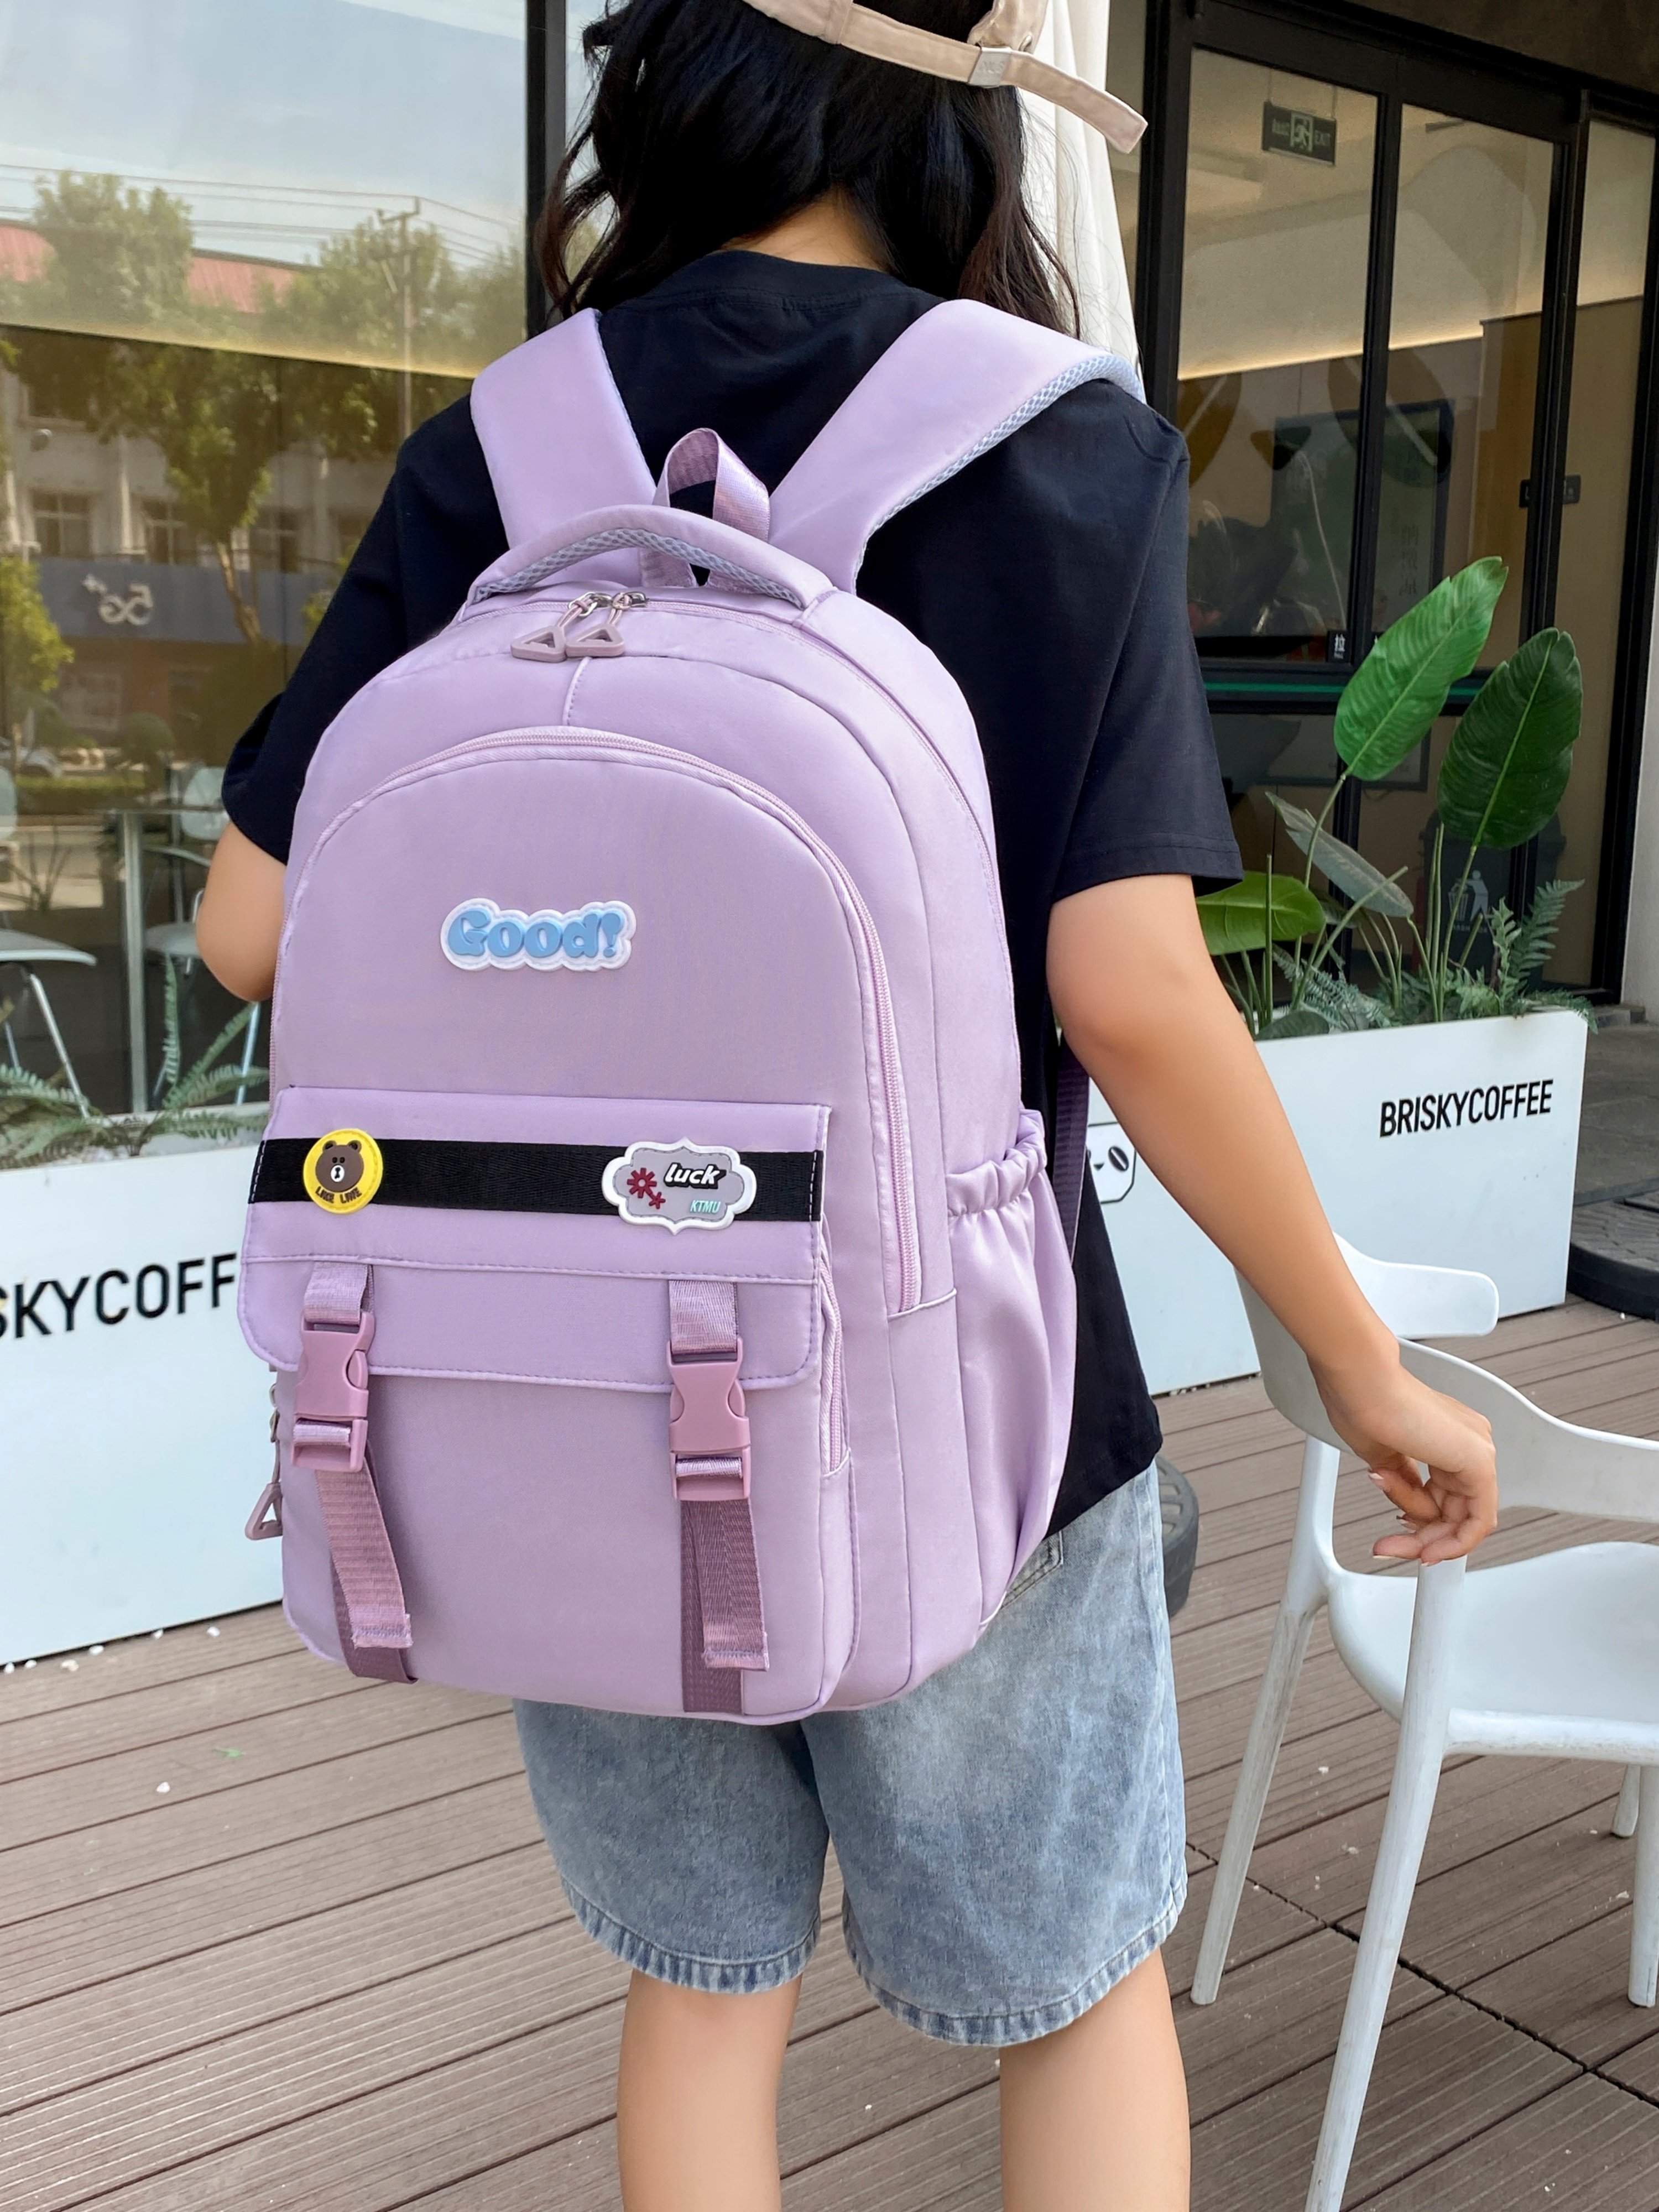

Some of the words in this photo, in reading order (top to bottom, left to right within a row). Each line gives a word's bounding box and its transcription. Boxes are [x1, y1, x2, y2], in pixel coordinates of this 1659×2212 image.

[448, 909, 623, 958] Good!
[1380, 1078, 1553, 1138] BRISKYCOFFEE
[664, 1162, 723, 1188] luck
[690, 1199, 721, 1213] KTMU
[0, 1251, 237, 1338] KYCOFF
